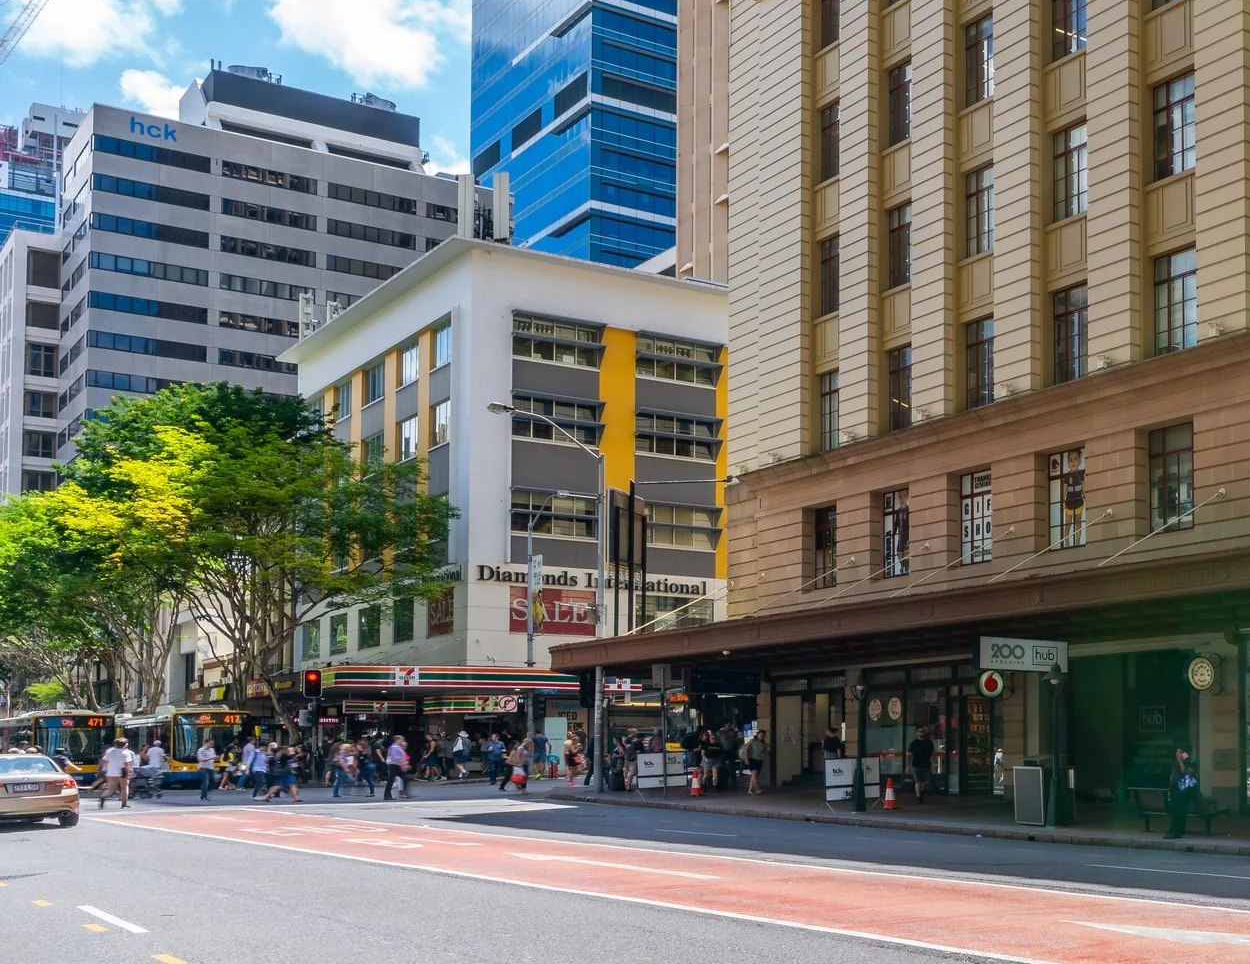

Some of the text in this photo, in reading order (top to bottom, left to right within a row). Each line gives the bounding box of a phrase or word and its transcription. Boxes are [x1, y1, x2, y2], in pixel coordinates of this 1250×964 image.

[130, 116, 177, 142] hck
[964, 499, 991, 515] GIF
[964, 521, 991, 538] SHO
[477, 565, 578, 587] Diamnds
[430, 599, 454, 624] SALE
[990, 643, 1025, 660] 200
[1035, 648, 1055, 661] hub
[61, 718, 104, 727] City 471
[223, 715, 240, 724] 417
[1142, 709, 1163, 725] hub
